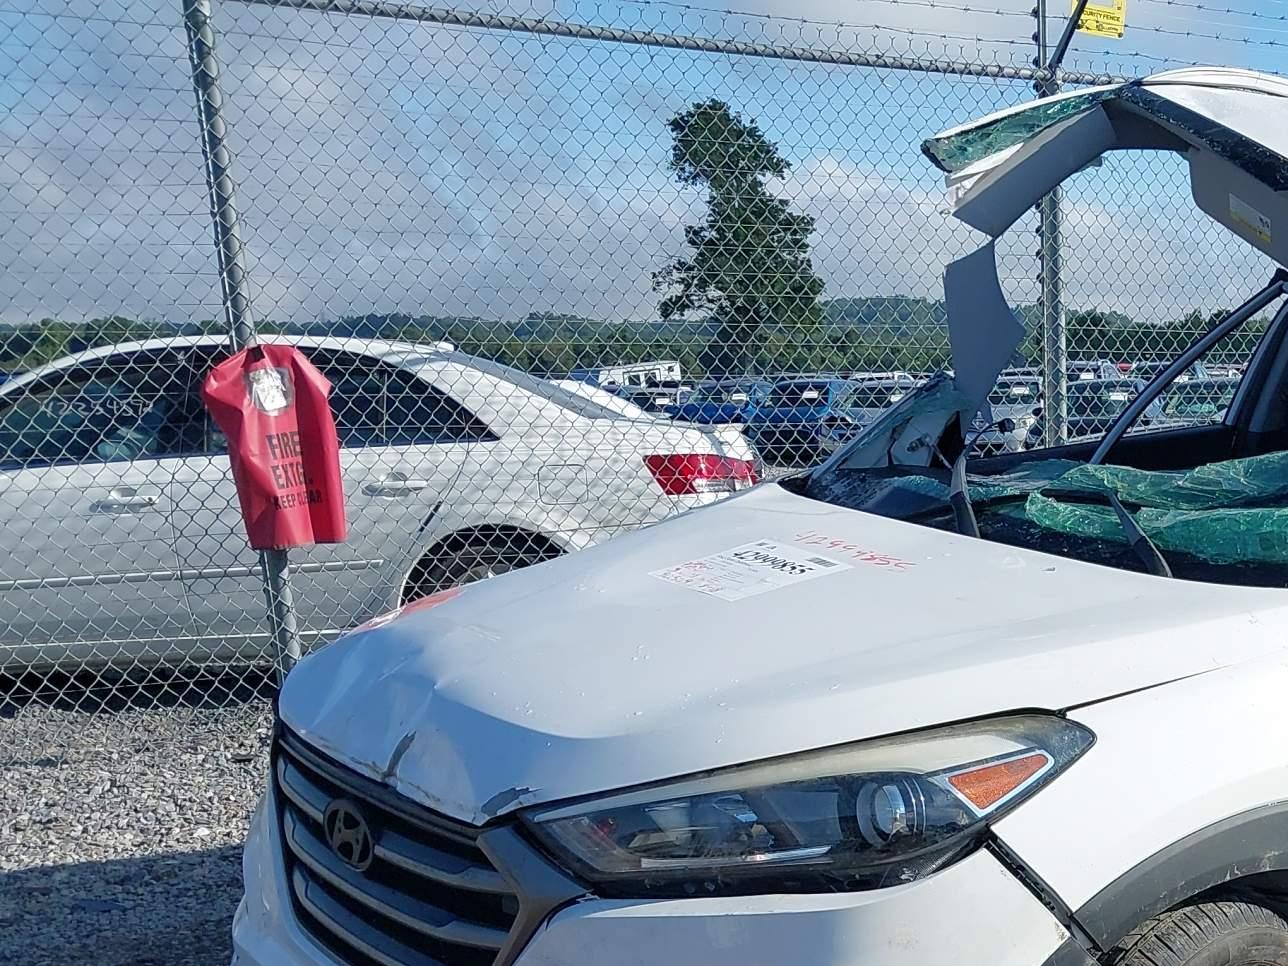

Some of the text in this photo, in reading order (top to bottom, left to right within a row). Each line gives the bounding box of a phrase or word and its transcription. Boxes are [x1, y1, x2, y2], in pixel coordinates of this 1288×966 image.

[1103, 14, 1121, 22] FENCE
[265, 431, 303, 460] FIRE
[272, 488, 322, 511] KEEP CLEAR
[731, 550, 817, 575] 42999855
